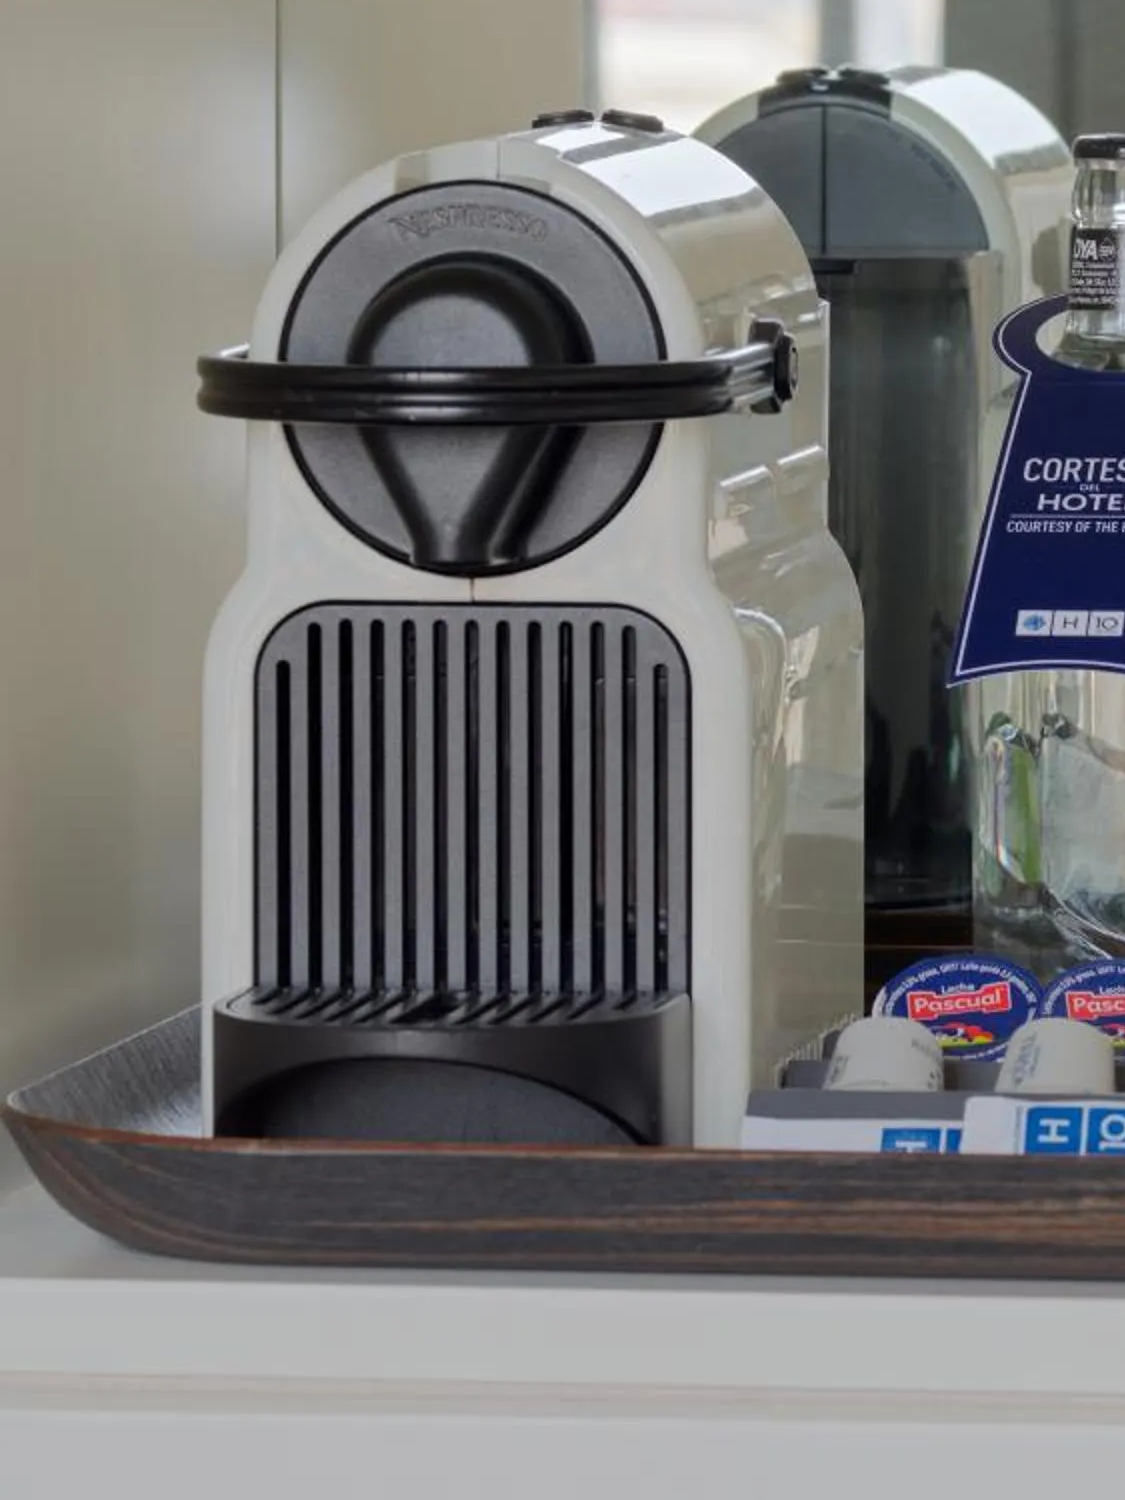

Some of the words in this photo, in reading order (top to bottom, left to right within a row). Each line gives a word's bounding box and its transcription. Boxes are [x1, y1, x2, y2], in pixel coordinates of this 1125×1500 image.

[1006, 520, 1072, 533] COURTESY
[1075, 520, 1091, 533] OF
[1095, 520, 1118, 533] THE
[1062, 615, 1079, 630] H
[913, 988, 1002, 1014] Pascual
[1036, 1117, 1071, 1145] H
